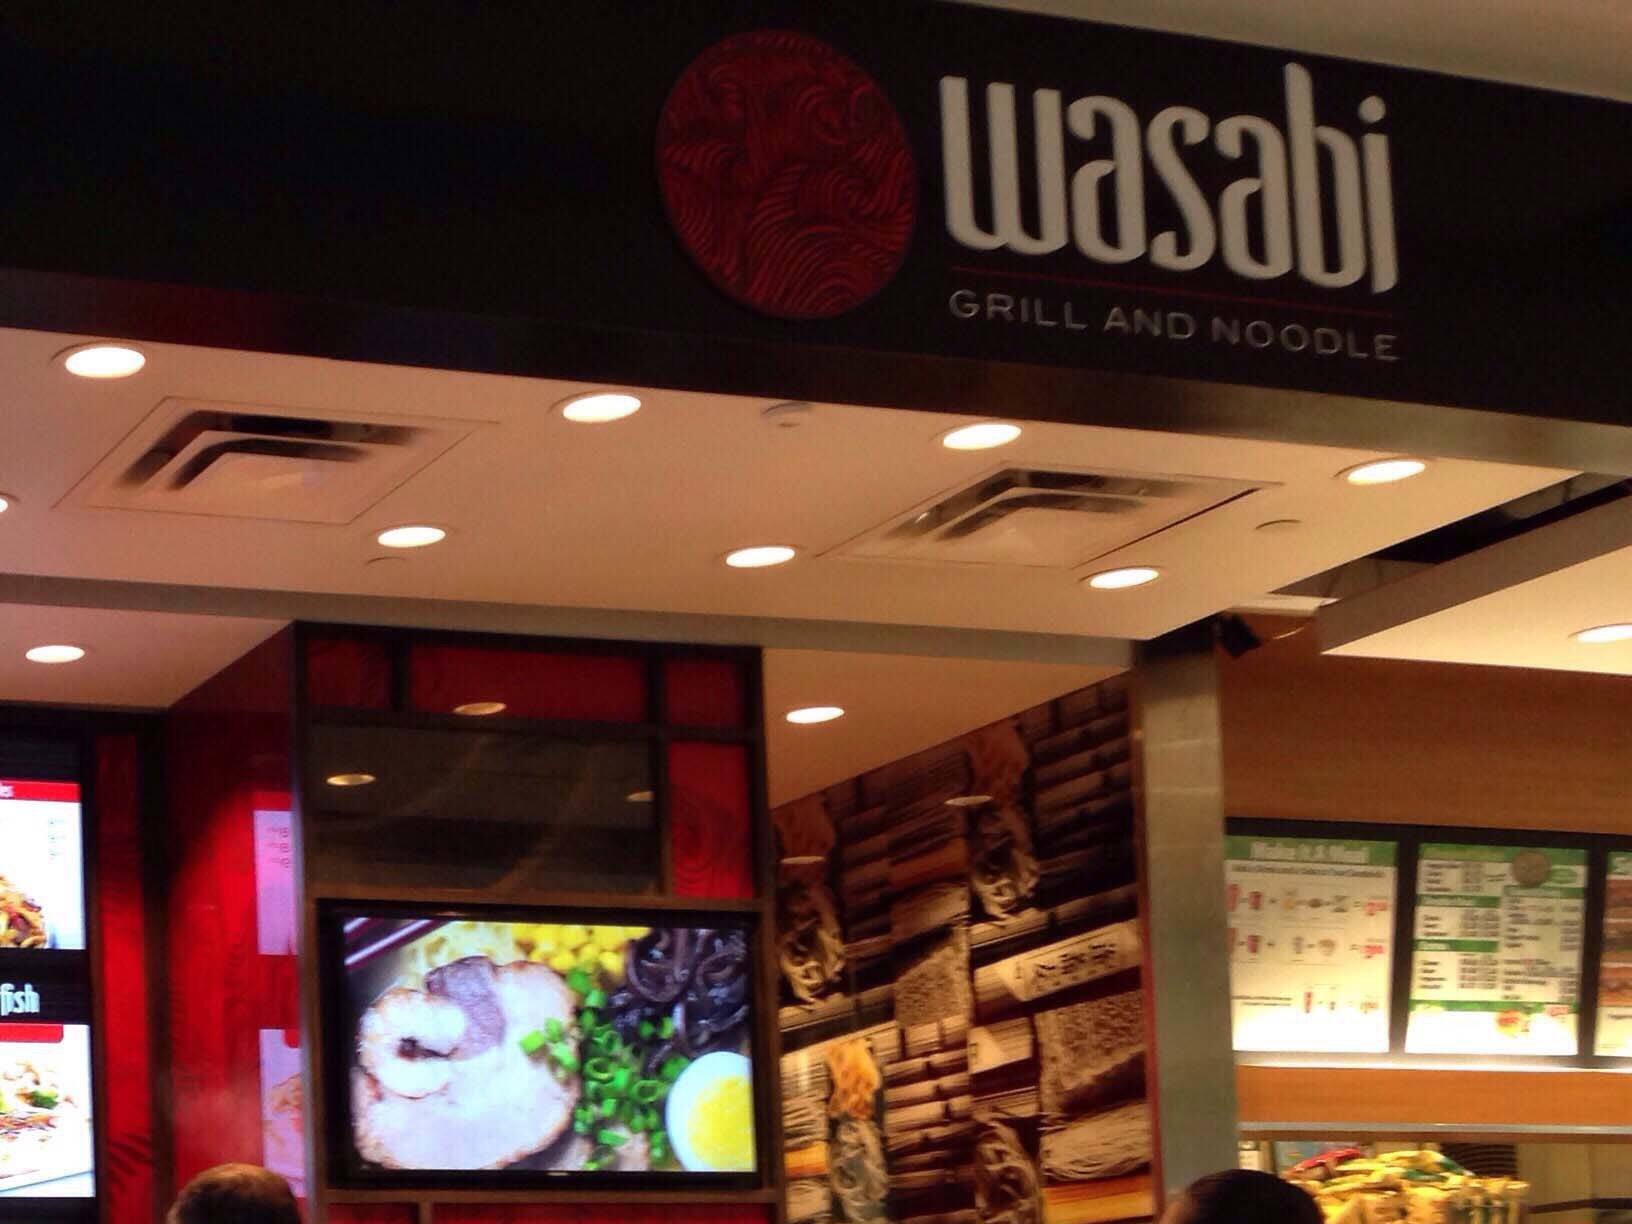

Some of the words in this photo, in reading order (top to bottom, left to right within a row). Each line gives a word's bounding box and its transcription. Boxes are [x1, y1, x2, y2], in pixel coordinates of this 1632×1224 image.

[941, 63, 1397, 294] wasabi
[949, 290, 1087, 330] GRILL
[1103, 307, 1195, 340] AND
[1212, 317, 1399, 361] NOODLE
[0, 983, 40, 1016] fish
